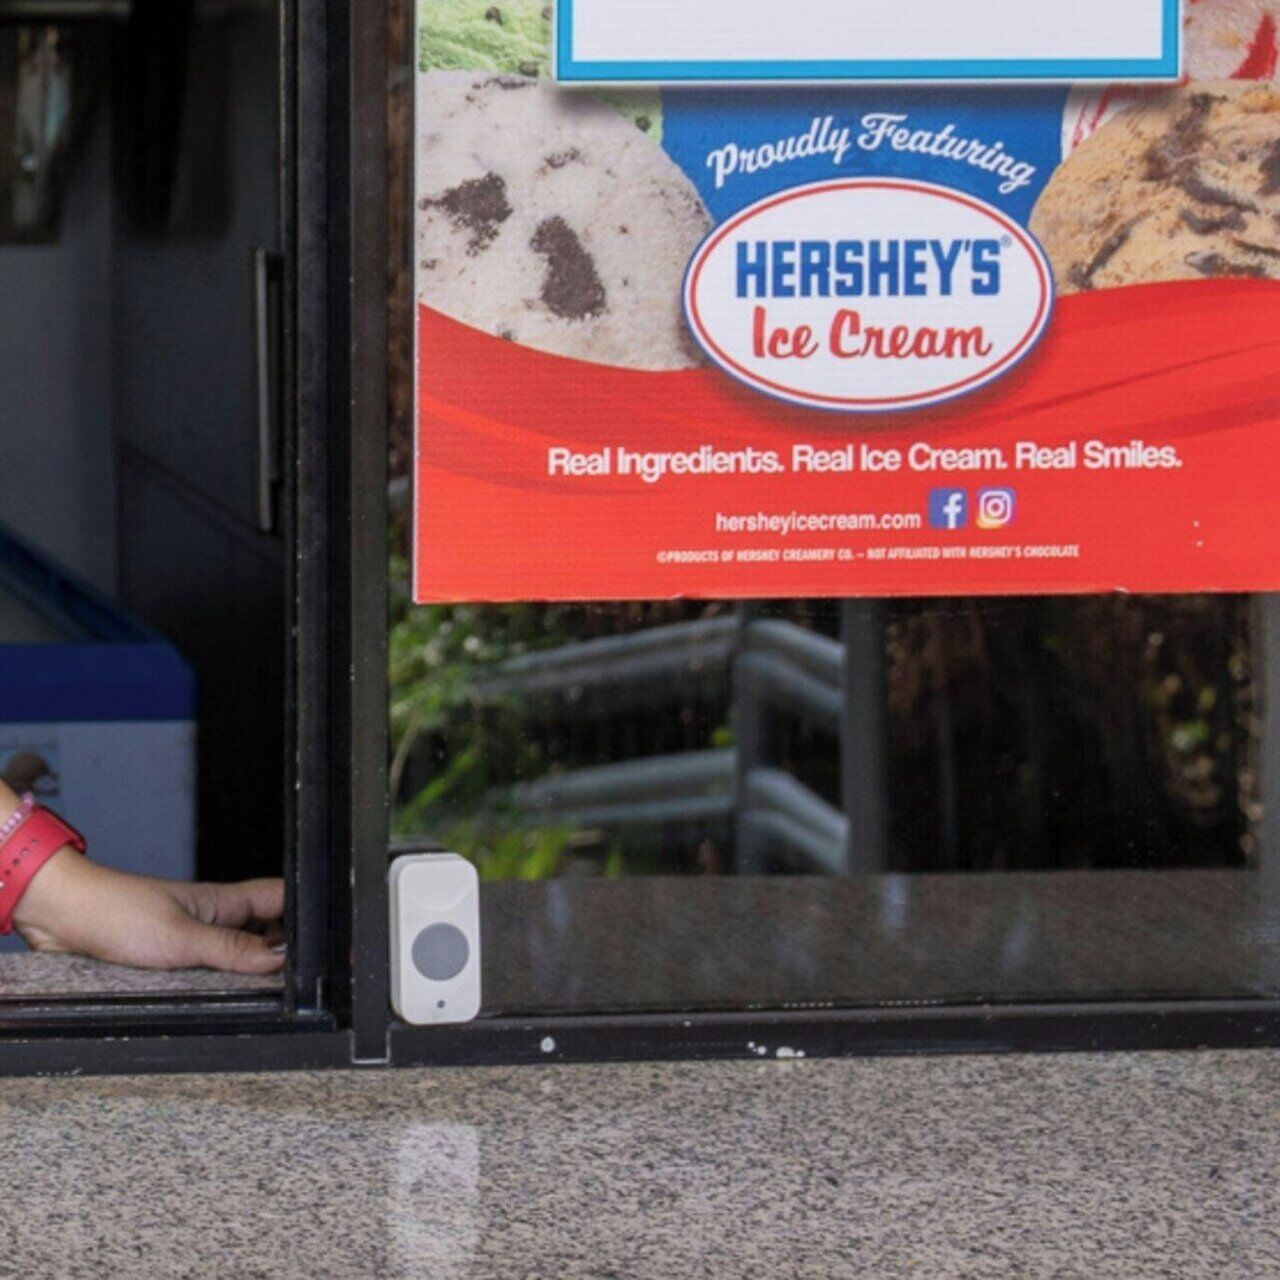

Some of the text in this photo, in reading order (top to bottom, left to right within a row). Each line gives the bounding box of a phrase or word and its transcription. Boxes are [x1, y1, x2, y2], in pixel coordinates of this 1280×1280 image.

[706, 112, 1037, 194] Proudly Featuring
[734, 238, 1002, 299] HERSHEY'S
[752, 305, 993, 360] Ice Cream
[548, 440, 1183, 482] Real Ingredients. Real Ice Cream. Real Smiles.
[715, 512, 921, 535] hersheyicecream.com
